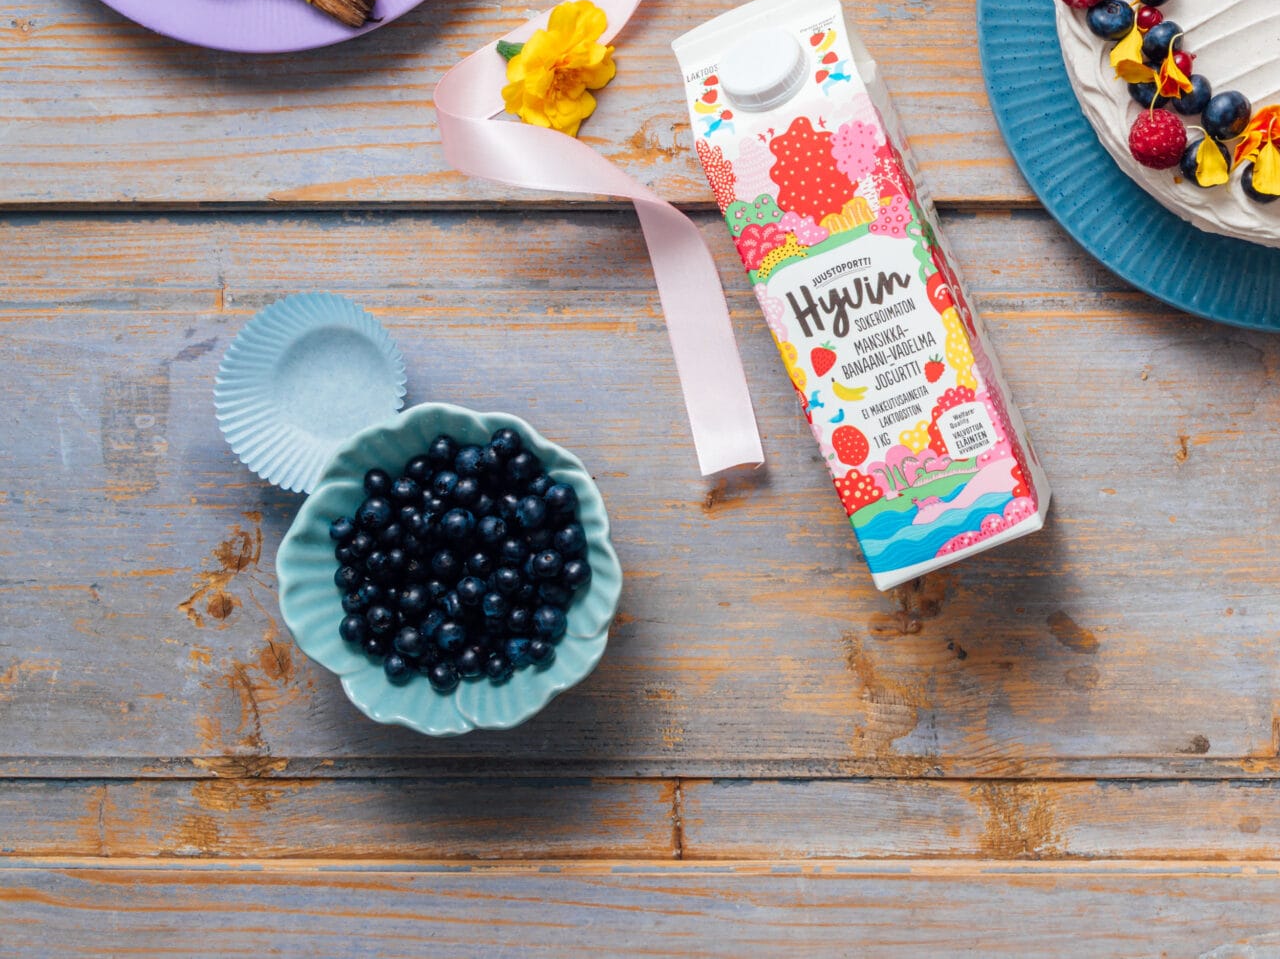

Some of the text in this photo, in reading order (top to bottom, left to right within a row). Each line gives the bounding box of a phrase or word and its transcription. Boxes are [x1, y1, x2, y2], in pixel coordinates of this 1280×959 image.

[812, 256, 872, 287] JUUSTOPORTTI
[786, 271, 911, 338] Hyvin
[854, 298, 916, 332] SOKEROIMATON
[841, 331, 937, 380] BANAANI-VADELMA
[853, 324, 909, 356] MANSIKKA-
[875, 360, 922, 391] JOGURTTI
[861, 385, 929, 420] EI MAKEUTUSAINEITA
[879, 403, 922, 429] LAKTOOSITON
[879, 432, 892, 447] KG
